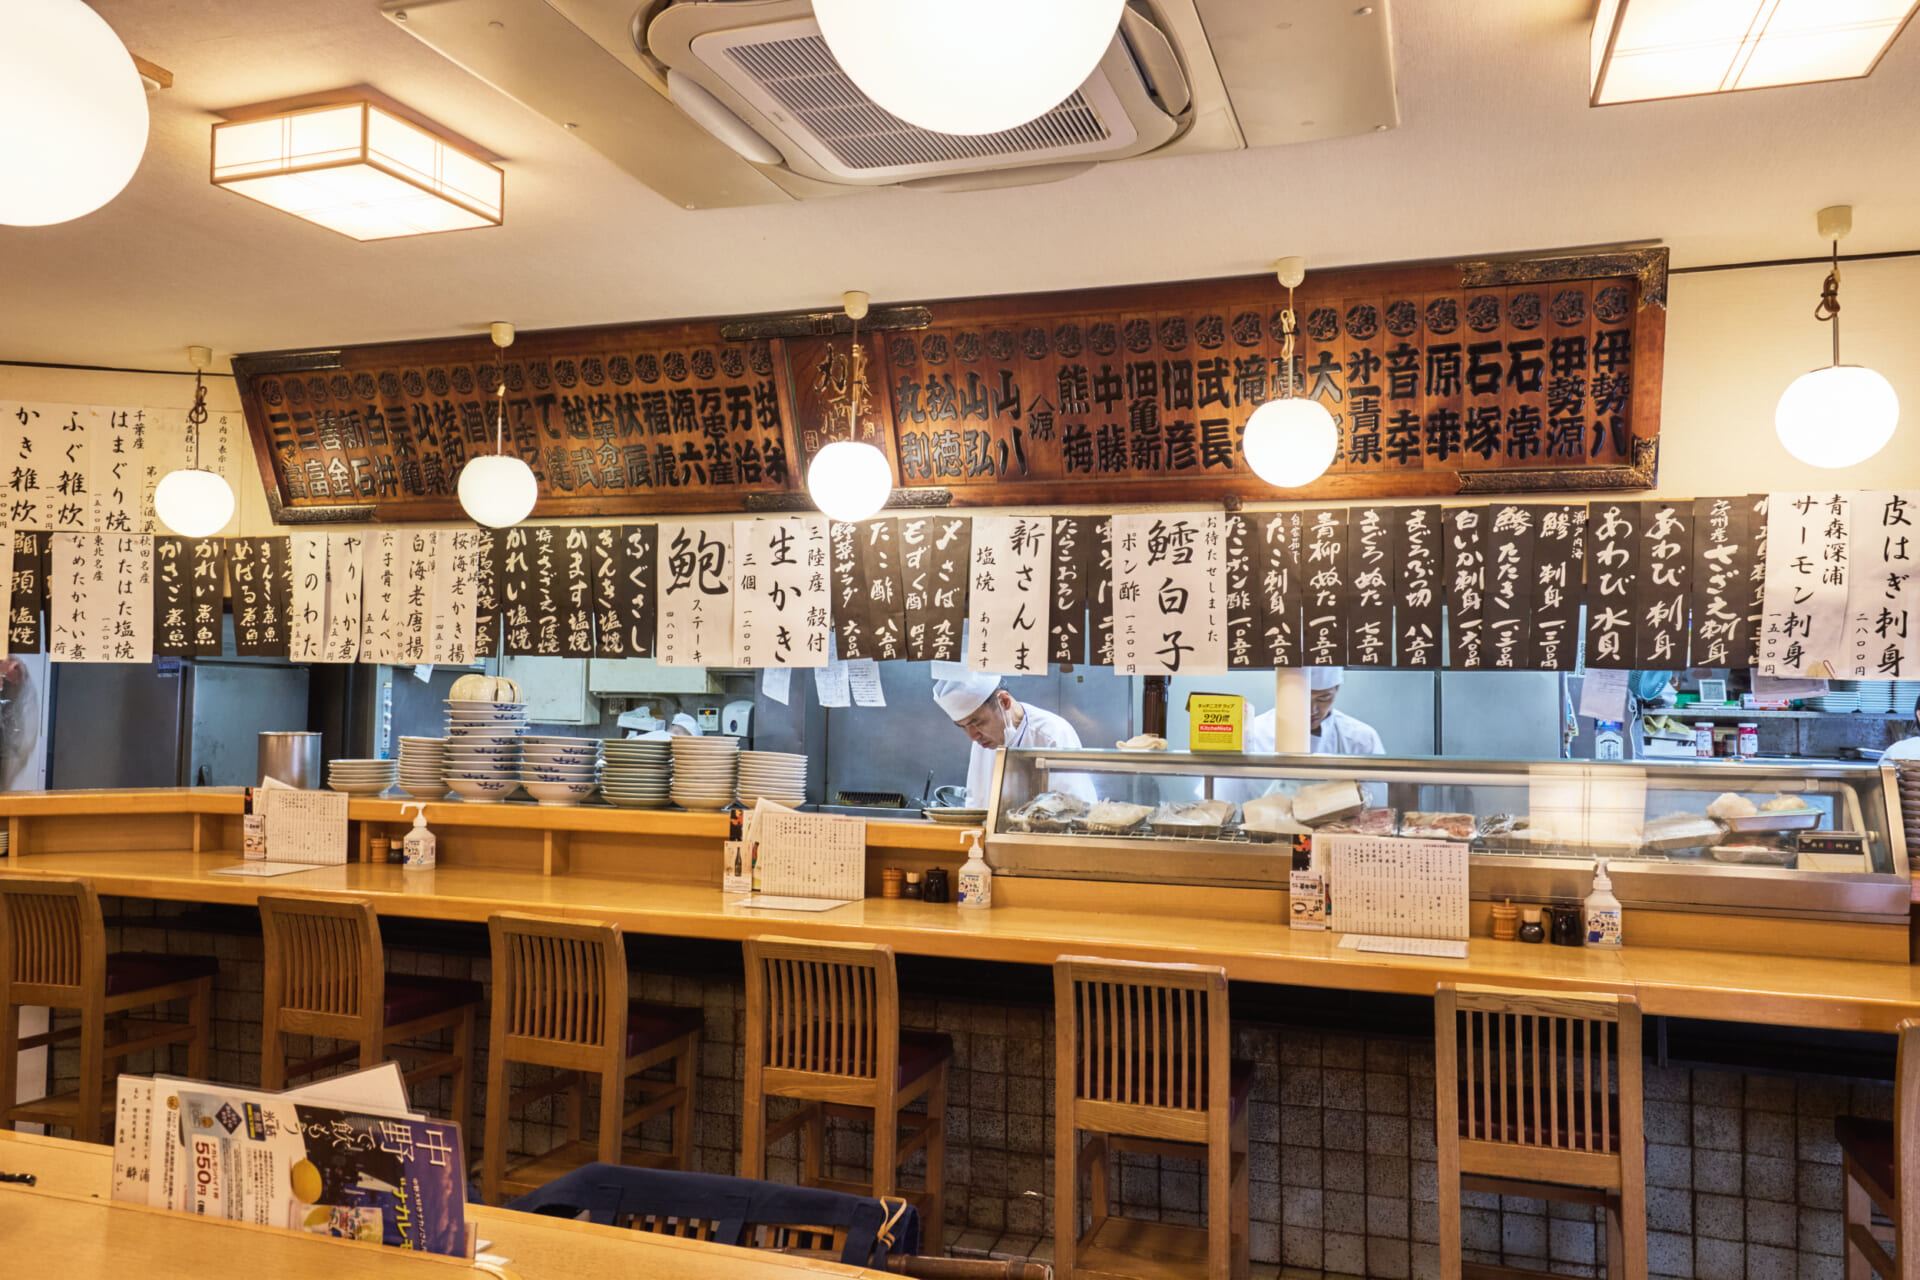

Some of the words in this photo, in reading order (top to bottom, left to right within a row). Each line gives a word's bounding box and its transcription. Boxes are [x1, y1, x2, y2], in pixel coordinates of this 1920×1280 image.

[9, 406, 40, 524] かき雑炊
[57, 411, 87, 527] ふぐ雑炊
[105, 410, 132, 532] はまぐり焼
[132, 410, 146, 450] 千葉産
[992, 370, 1028, 476] 山八
[93, 535, 104, 581] 東北名産
[139, 536, 151, 584] 秋田名産
[193, 539, 218, 646] かれい煮魚
[505, 528, 532, 649] かれい塩焼
[566, 528, 592, 652] かます塩焼
[595, 529, 624, 653] きんき塩焼
[626, 528, 650, 652] ふぐさし
[666, 527, 729, 595] 鮑
[741, 553, 757, 591] 三個
[808, 526, 826, 592] 三陸産
[831, 522, 858, 608] 野菜サラダ
[870, 521, 894, 604] たこ酢
[976, 546, 996, 592] 塩焼
[1055, 519, 1078, 610] たらこおろし
[1119, 533, 1140, 602] ポン酢
[1205, 516, 1219, 643] お待たせしました
[1264, 513, 1288, 615] たこ刺身
[1308, 512, 1342, 606] 青柳ぬた
[1354, 509, 1387, 607] まぐろぬた
[1454, 510, 1485, 616] 白いか刺身
[1645, 508, 1686, 661] あわび刺身
[1782, 495, 1819, 669] サーモン刺身
[1823, 494, 1848, 586] 青森深浦
[1875, 495, 1912, 678] 皮はぎ刺身
[54, 624, 68, 655] 入荷
[70, 535, 87, 659] なめたかれい煮
[114, 537, 136, 659] はたはた塩焼
[158, 541, 189, 649] かさご煮魚
[231, 542, 259, 646] めばる煮魚
[303, 540, 319, 656] このわた
[338, 537, 361, 660] やりいか煮
[448, 532, 469, 664] 桜海老かき揚
[692, 600, 704, 663] ステーキ
[768, 527, 802, 663] 生かき
[806, 606, 828, 652] 殻付
[978, 611, 990, 668] あります
[1009, 520, 1045, 671] 新さんま
[1148, 519, 1200, 672] 鱈白子
[1698, 545, 1742, 665] さざえ刺身
